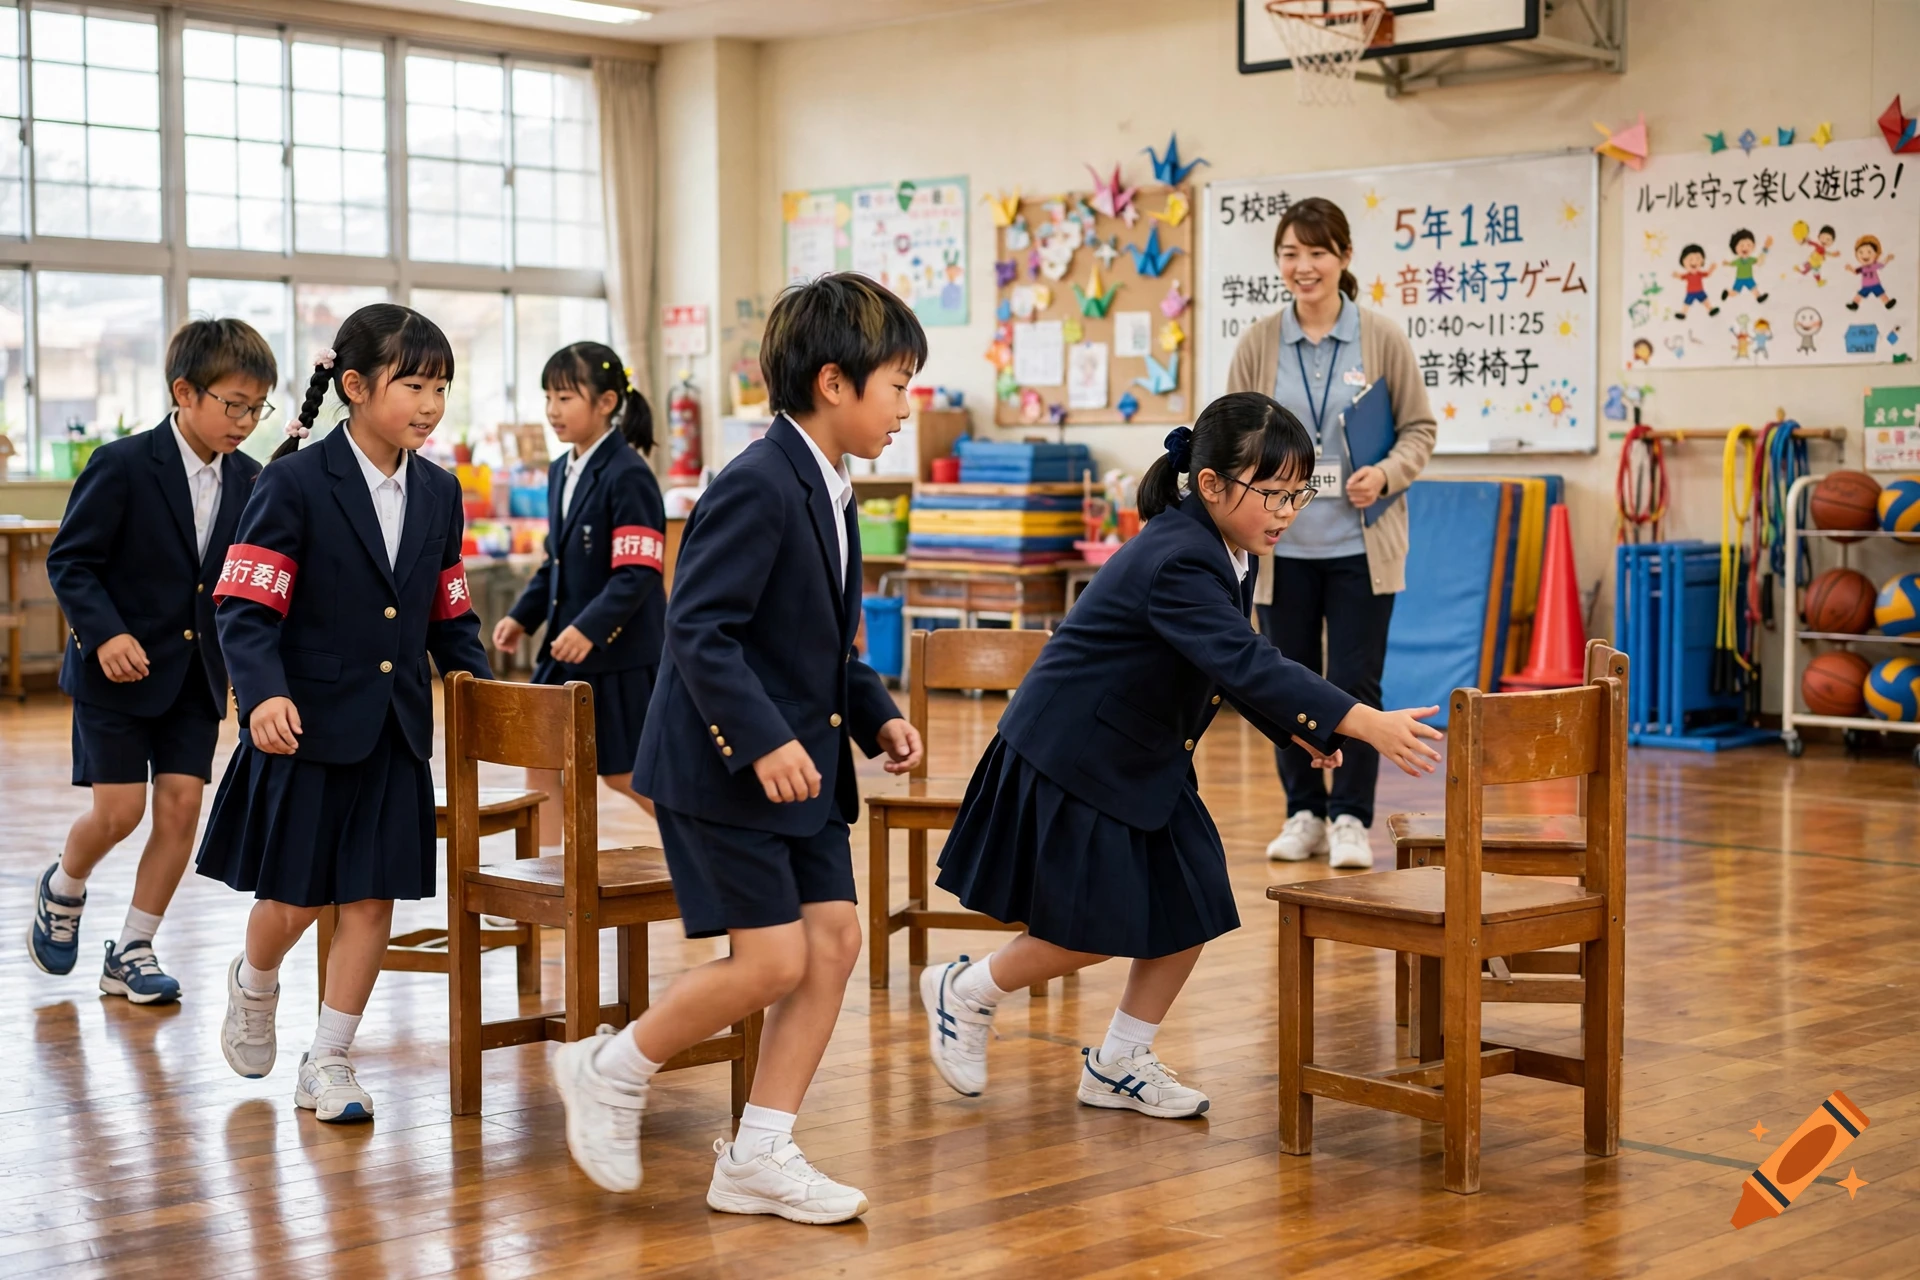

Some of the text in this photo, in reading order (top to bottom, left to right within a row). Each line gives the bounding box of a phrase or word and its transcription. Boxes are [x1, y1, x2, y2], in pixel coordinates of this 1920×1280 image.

[1636, 162, 1904, 213] ルールを守って楽しく遊ぼう！
[1394, 202, 1524, 251] 5年1組
[1394, 259, 1588, 305] 音楽椅子ゲーム
[1419, 346, 1539, 388] 音楽椅子
